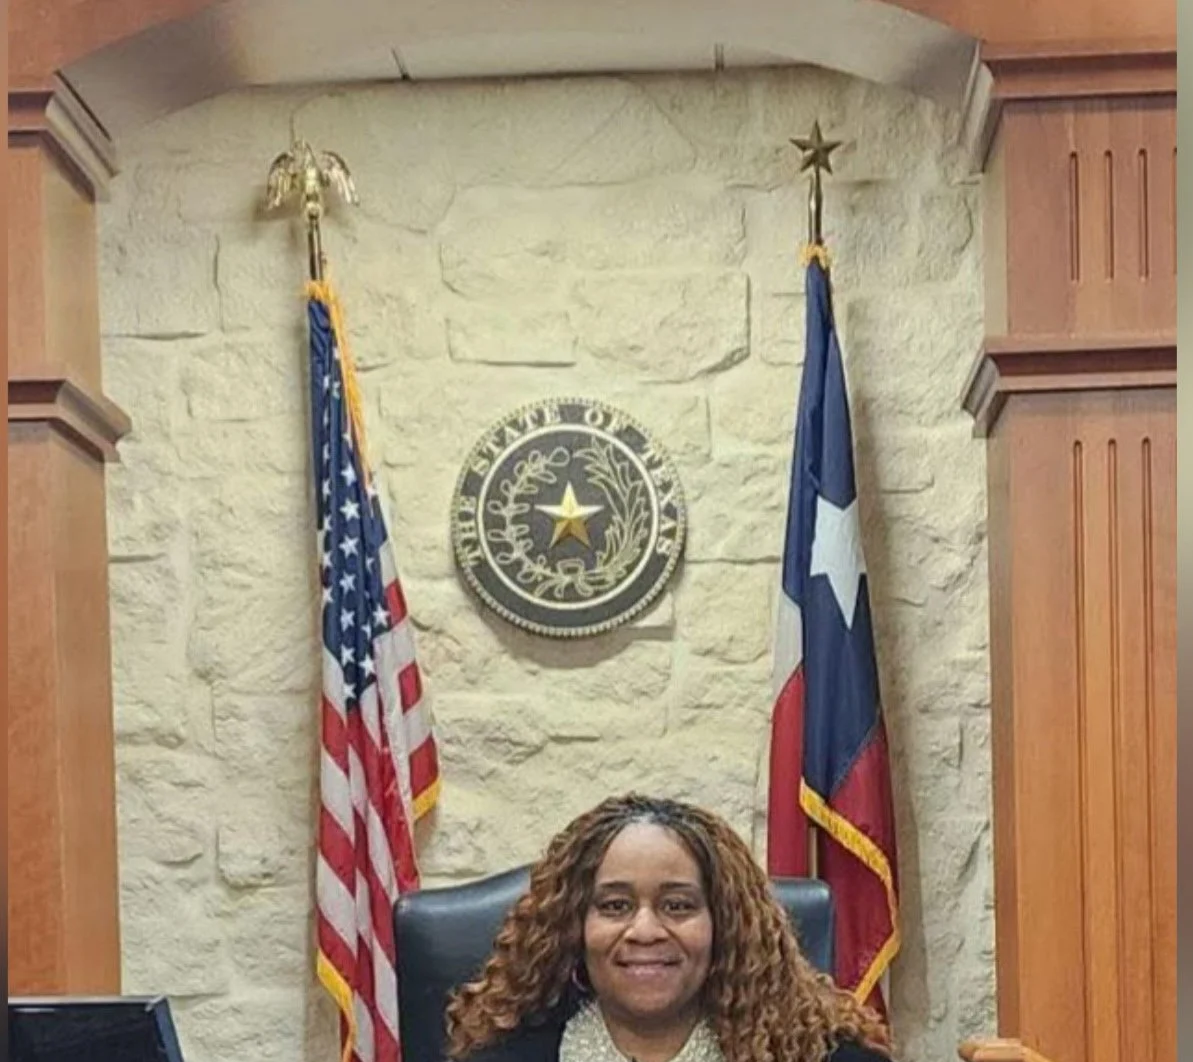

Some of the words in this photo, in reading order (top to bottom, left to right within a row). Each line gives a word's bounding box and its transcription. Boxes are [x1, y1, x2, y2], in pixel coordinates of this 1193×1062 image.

[457, 496, 484, 567] THE
[471, 406, 561, 476] STATE
[584, 407, 625, 434] OF
